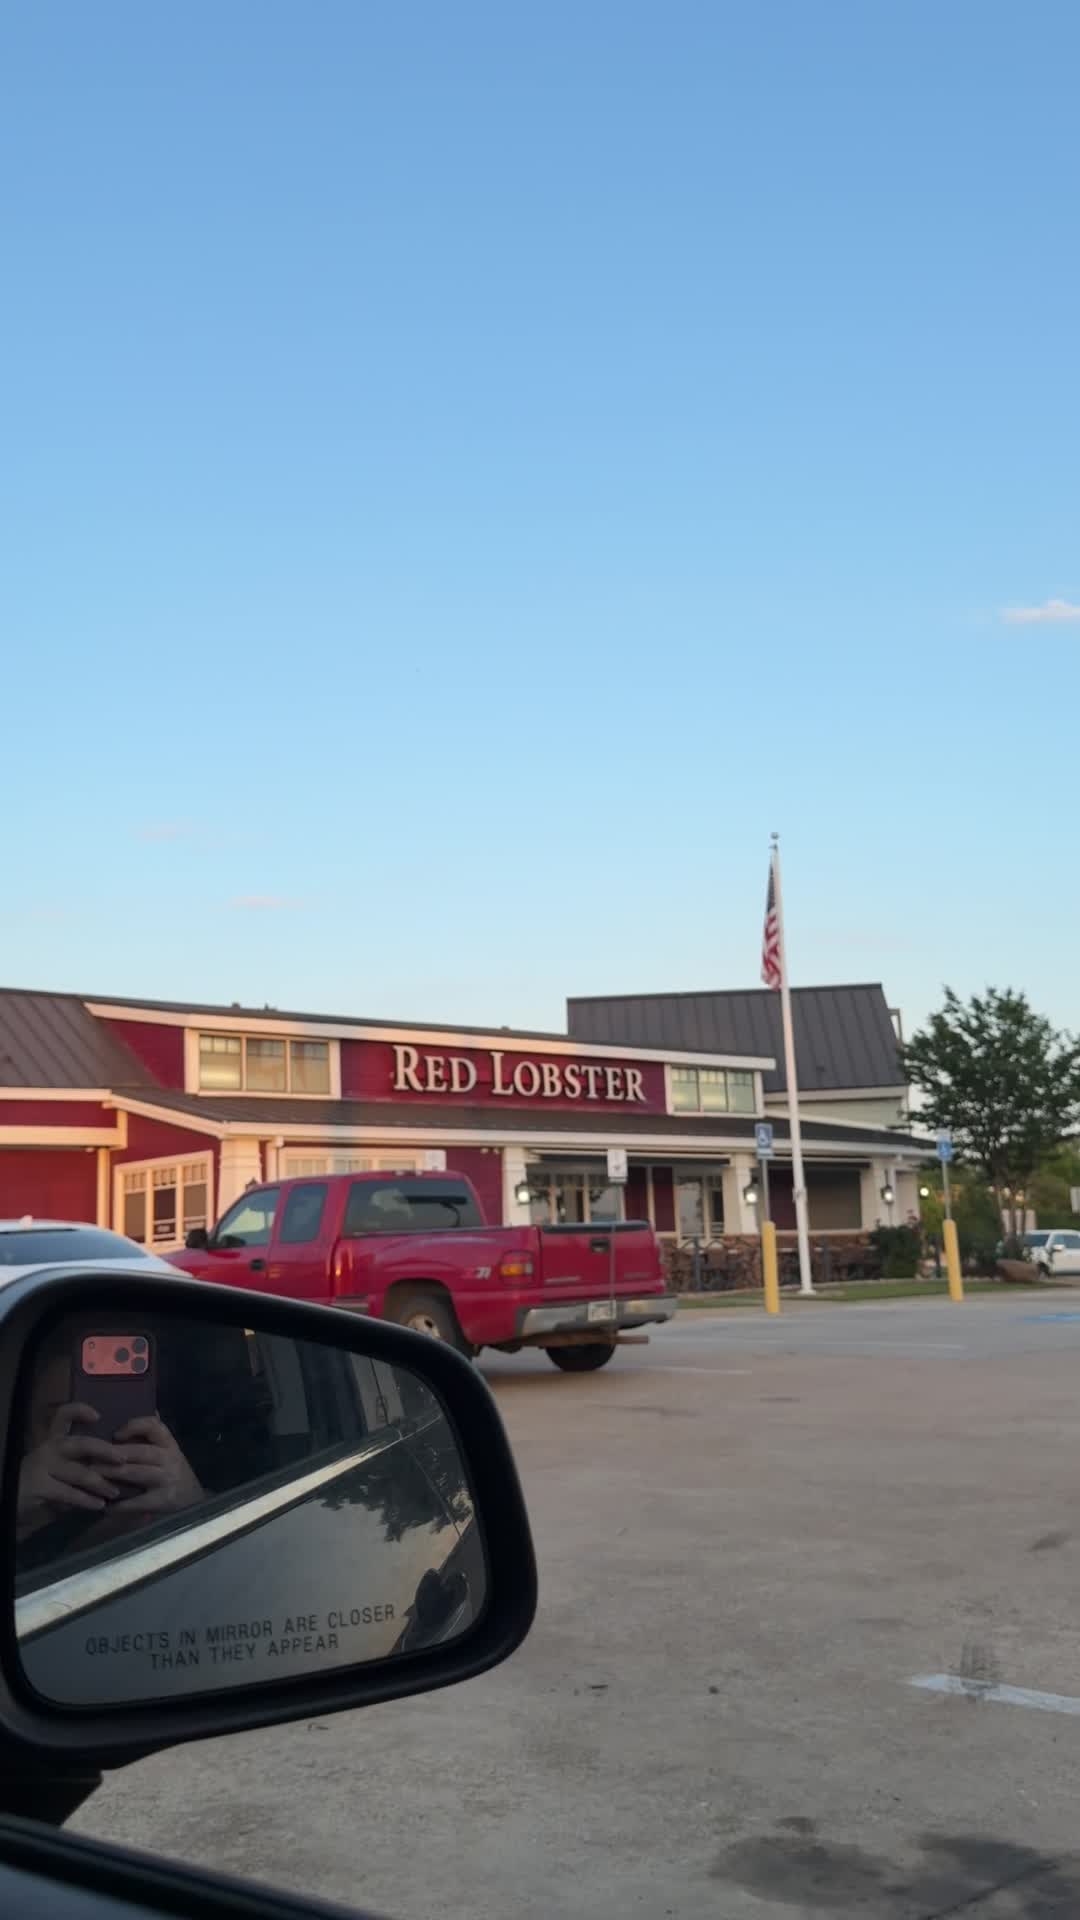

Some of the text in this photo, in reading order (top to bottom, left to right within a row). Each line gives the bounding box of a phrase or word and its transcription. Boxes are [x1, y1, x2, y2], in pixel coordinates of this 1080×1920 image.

[392, 1044, 646, 1101] RED LOBSTER
[85, 1603, 396, 1656] OBJECTS IN MIRROR ARE CLOSER
[151, 1633, 339, 1671] THAN THEY APPEAR
